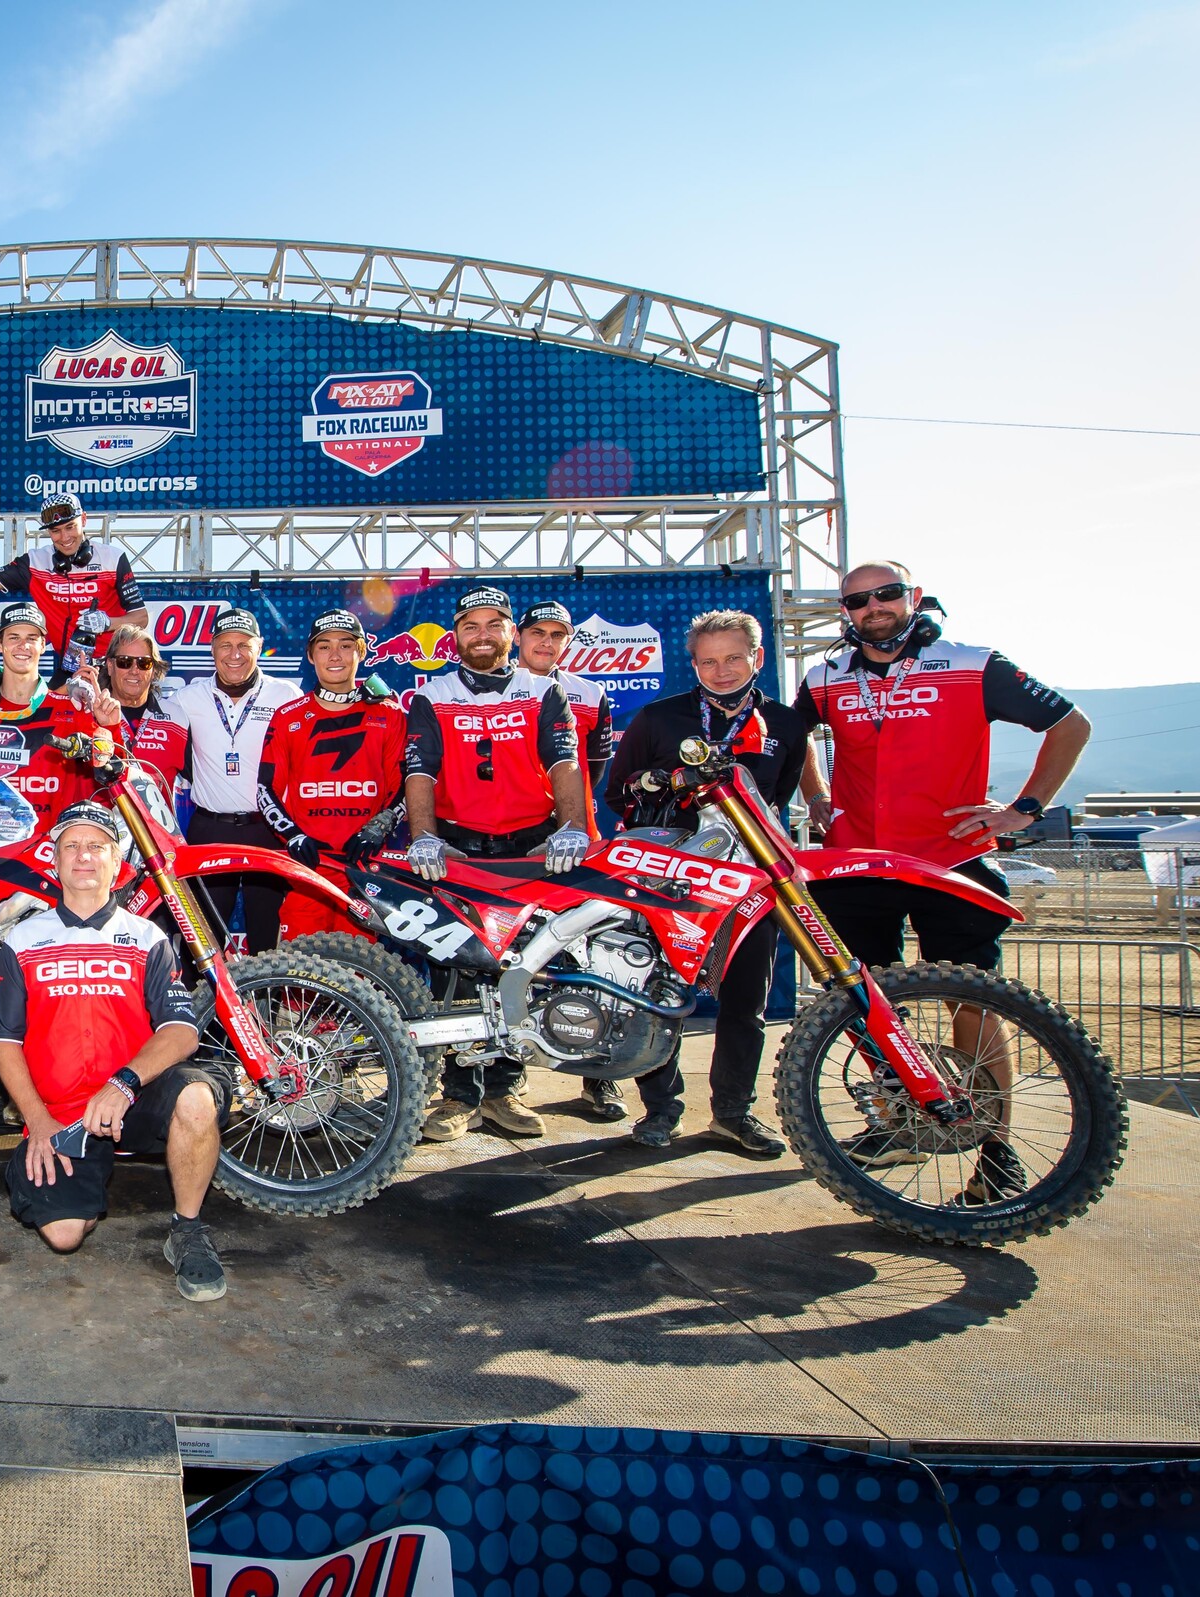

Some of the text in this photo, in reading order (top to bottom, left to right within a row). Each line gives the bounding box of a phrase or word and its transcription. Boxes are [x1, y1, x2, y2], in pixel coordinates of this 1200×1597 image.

[54, 356, 166, 379] LUCAS OIL
[34, 395, 188, 416] MOTOCROSS
[341, 395, 398, 408] ALL OUT
[34, 413, 188, 423] CHAMPIONSHIP
[317, 415, 428, 436] FOX RACEWAY
[89, 439, 117, 449] AMA
[334, 440, 411, 450] NATIONAL
[24, 474, 197, 498] @promotocross
[45, 581, 98, 594] GEICO
[52, 595, 94, 603] HONDA
[460, 590, 504, 606] GEICO
[465, 599, 502, 608] HONDA
[5, 607, 43, 622] GEICO
[10, 616, 41, 624] HONDA
[315, 614, 355, 627] GEICO
[531, 607, 569, 619] GEICO
[217, 615, 253, 628] GEICO
[320, 621, 353, 629] HONDA
[601, 636, 658, 645] PERFORMANCE
[555, 645, 656, 673] LUCAS
[922, 662, 946, 671] 100%
[596, 677, 660, 690] ODUCTS
[318, 687, 362, 703] 100%
[837, 687, 938, 711] GEICO
[454, 712, 527, 731] GEICO
[846, 707, 931, 723] HONDA
[8, 777, 60, 793] EICO
[299, 780, 378, 798] GEICO
[307, 807, 371, 817] HONDA
[198, 857, 231, 870] ALIAS
[829, 862, 869, 877] ALIAS
[607, 847, 751, 897] GEICO
[164, 894, 196, 943] SHOWA
[384, 900, 475, 962] 84
[791, 904, 840, 957] SHOWA
[667, 931, 705, 946] HONDA
[672, 939, 698, 952] HRC
[36, 960, 132, 982] GEICO
[286, 969, 350, 993] DUNLOP
[47, 985, 126, 996] HONDA
[233, 1006, 264, 1056] DUNLOP
[890, 1020, 934, 1074] DUNLOP
[972, 1203, 1050, 1230] DUNLOP
